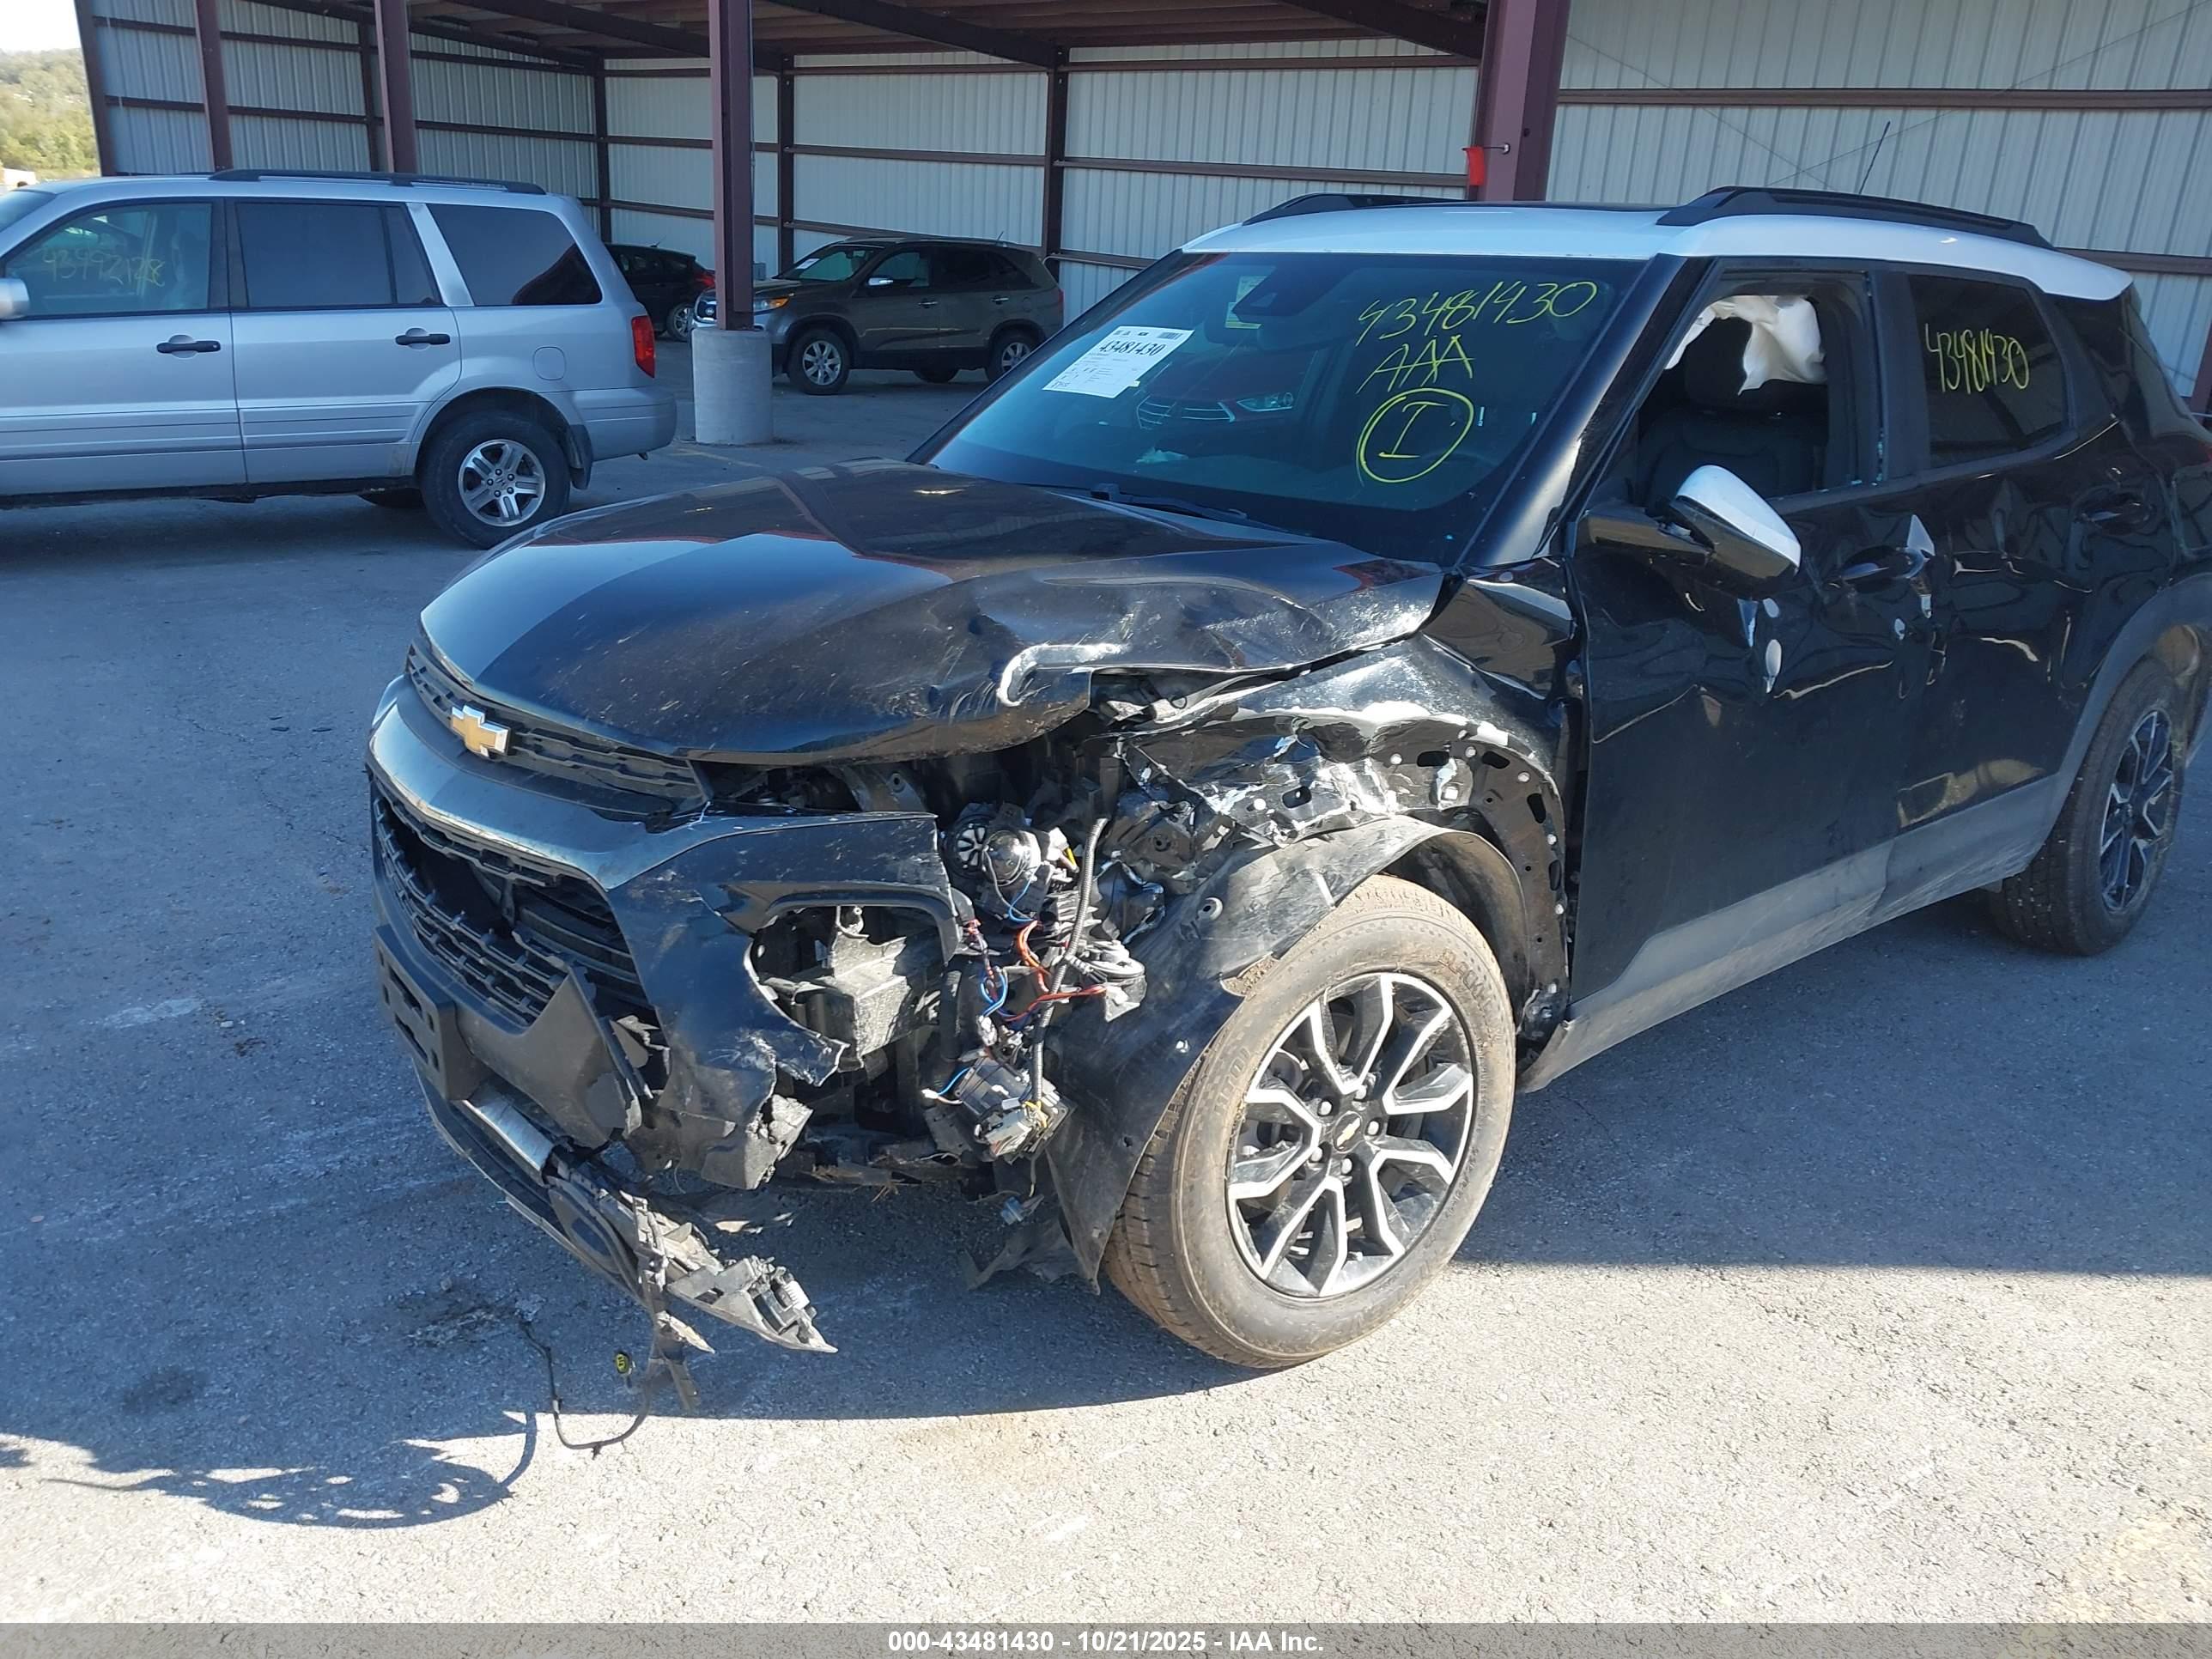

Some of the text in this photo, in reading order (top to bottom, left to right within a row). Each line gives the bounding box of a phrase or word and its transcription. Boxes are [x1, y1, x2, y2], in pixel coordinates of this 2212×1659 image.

[1354, 280, 1598, 347] 43481430
[1098, 340, 1167, 357] 43481430
[1924, 322, 2030, 395] 43481430
